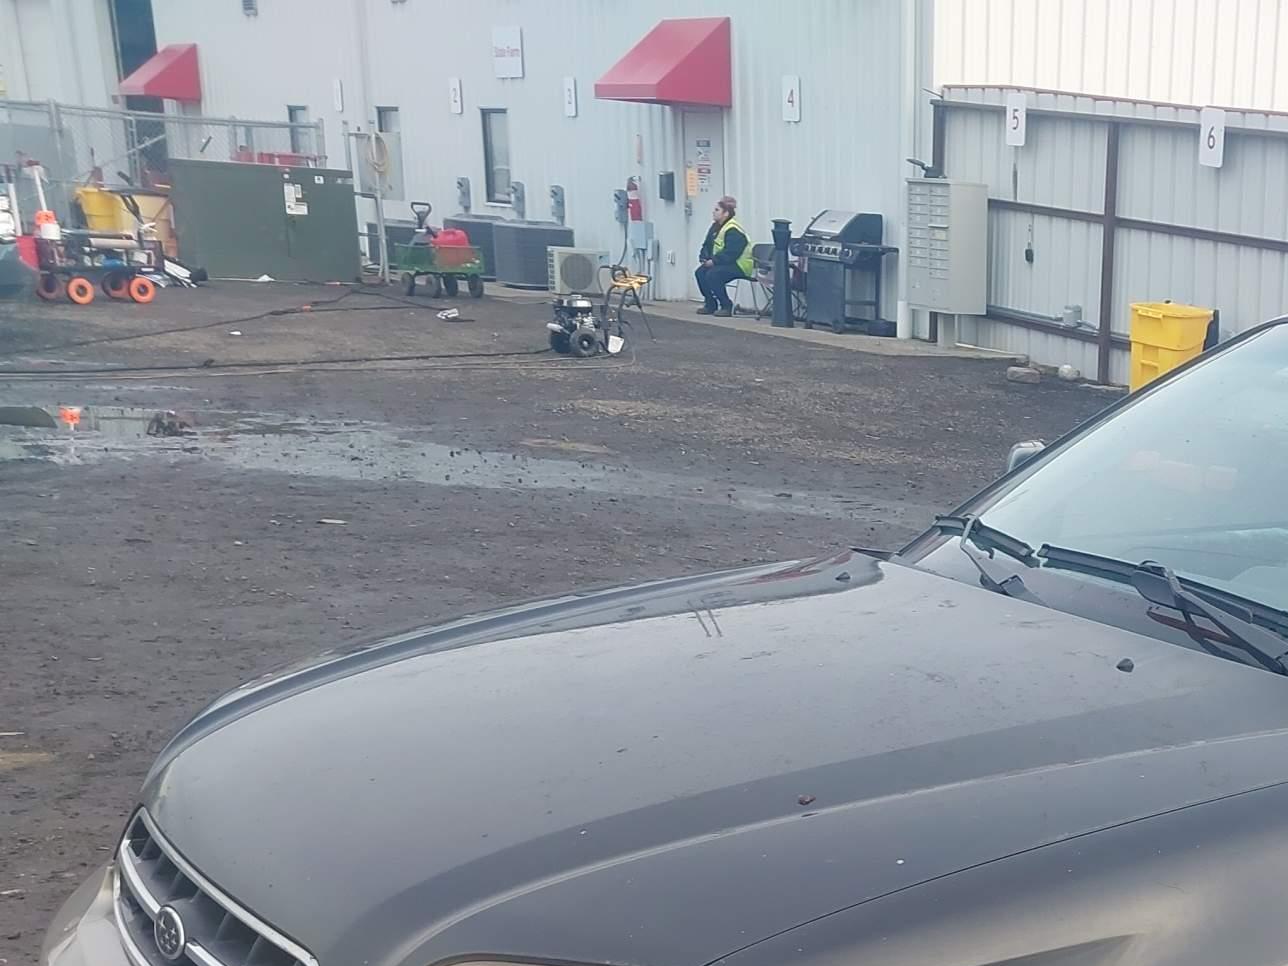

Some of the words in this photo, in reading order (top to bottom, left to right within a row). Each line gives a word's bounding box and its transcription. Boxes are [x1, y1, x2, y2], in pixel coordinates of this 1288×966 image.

[787, 88, 795, 108] 4
[1011, 108, 1019, 131] 5
[1207, 126, 1216, 150] 6
